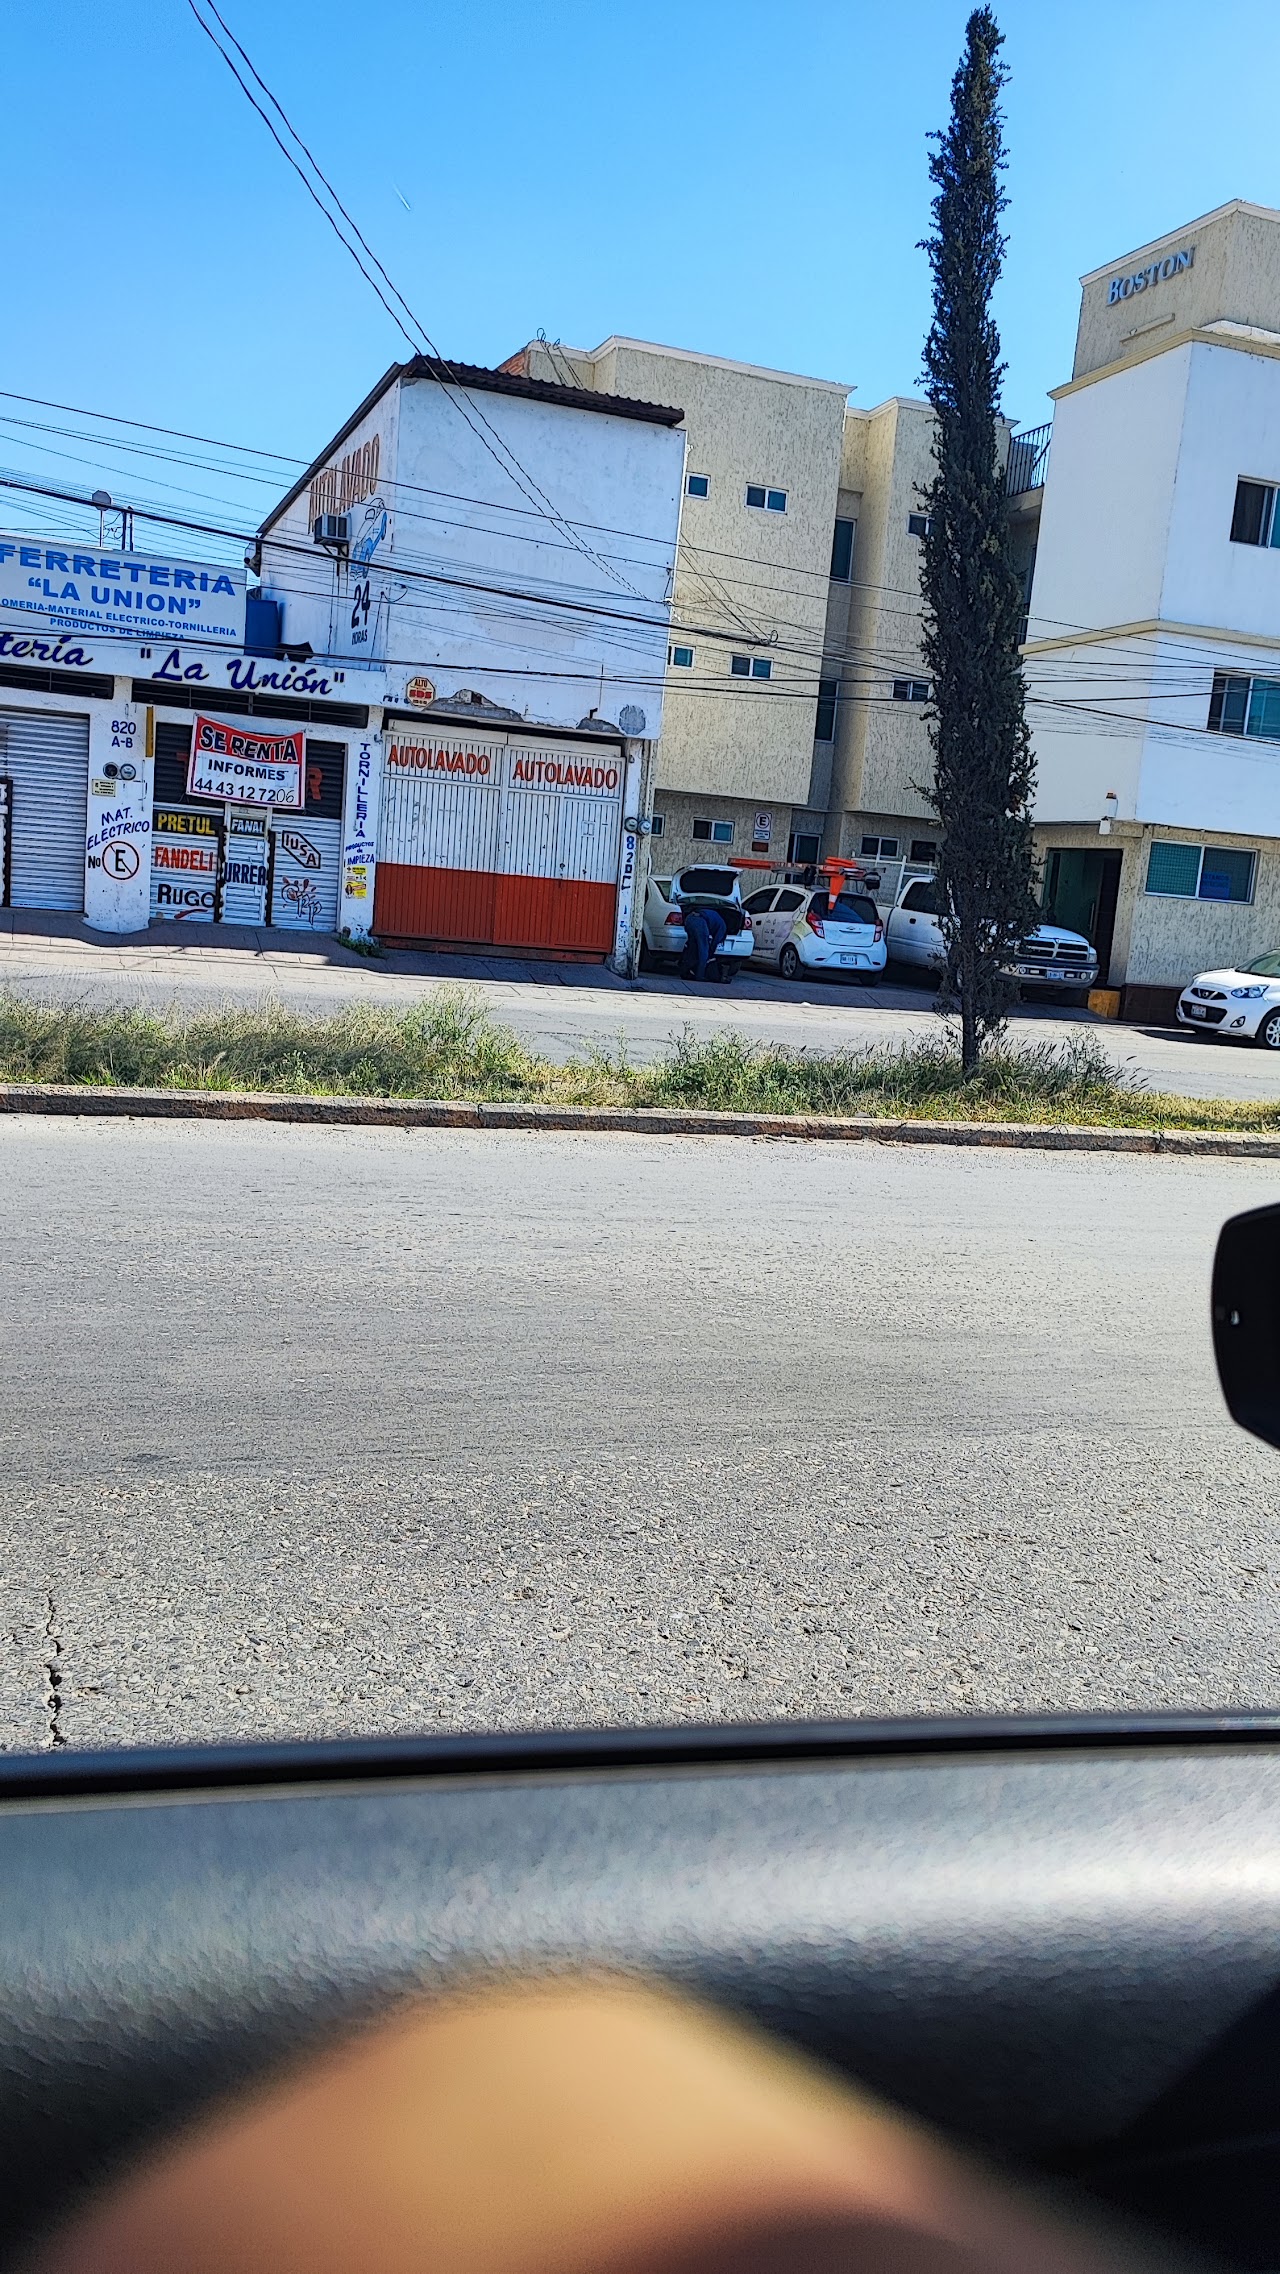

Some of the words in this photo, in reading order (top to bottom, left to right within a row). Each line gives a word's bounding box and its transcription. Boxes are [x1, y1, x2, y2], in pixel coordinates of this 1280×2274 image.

[1107, 246, 1196, 307] BOSTON
[0, 543, 236, 596] FERRETERIA
[351, 580, 371, 629] 24
[50, 618, 116, 633] PRODUCTOS
[119, 627, 133, 636] DE
[111, 720, 137, 735] 820
[111, 735, 133, 748] A-B
[200, 725, 227, 752] SE
[230, 736, 298, 762] RENTA
[208, 759, 285, 781] INFORMES
[387, 745, 491, 775] AUTOLAVADO
[512, 760, 618, 789] AUTOLAVADO
[355, 743, 371, 838] TORNILLERIA
[101, 807, 133, 826] MAT.
[157, 813, 216, 835] PRETUL
[231, 818, 265, 833] FANAL
[87, 820, 150, 850] ELECTRICO
[115, 849, 126, 872] E
[154, 846, 213, 871] FANDELI
[285, 834, 317, 866] IUSA
[225, 862, 267, 885] URREA
